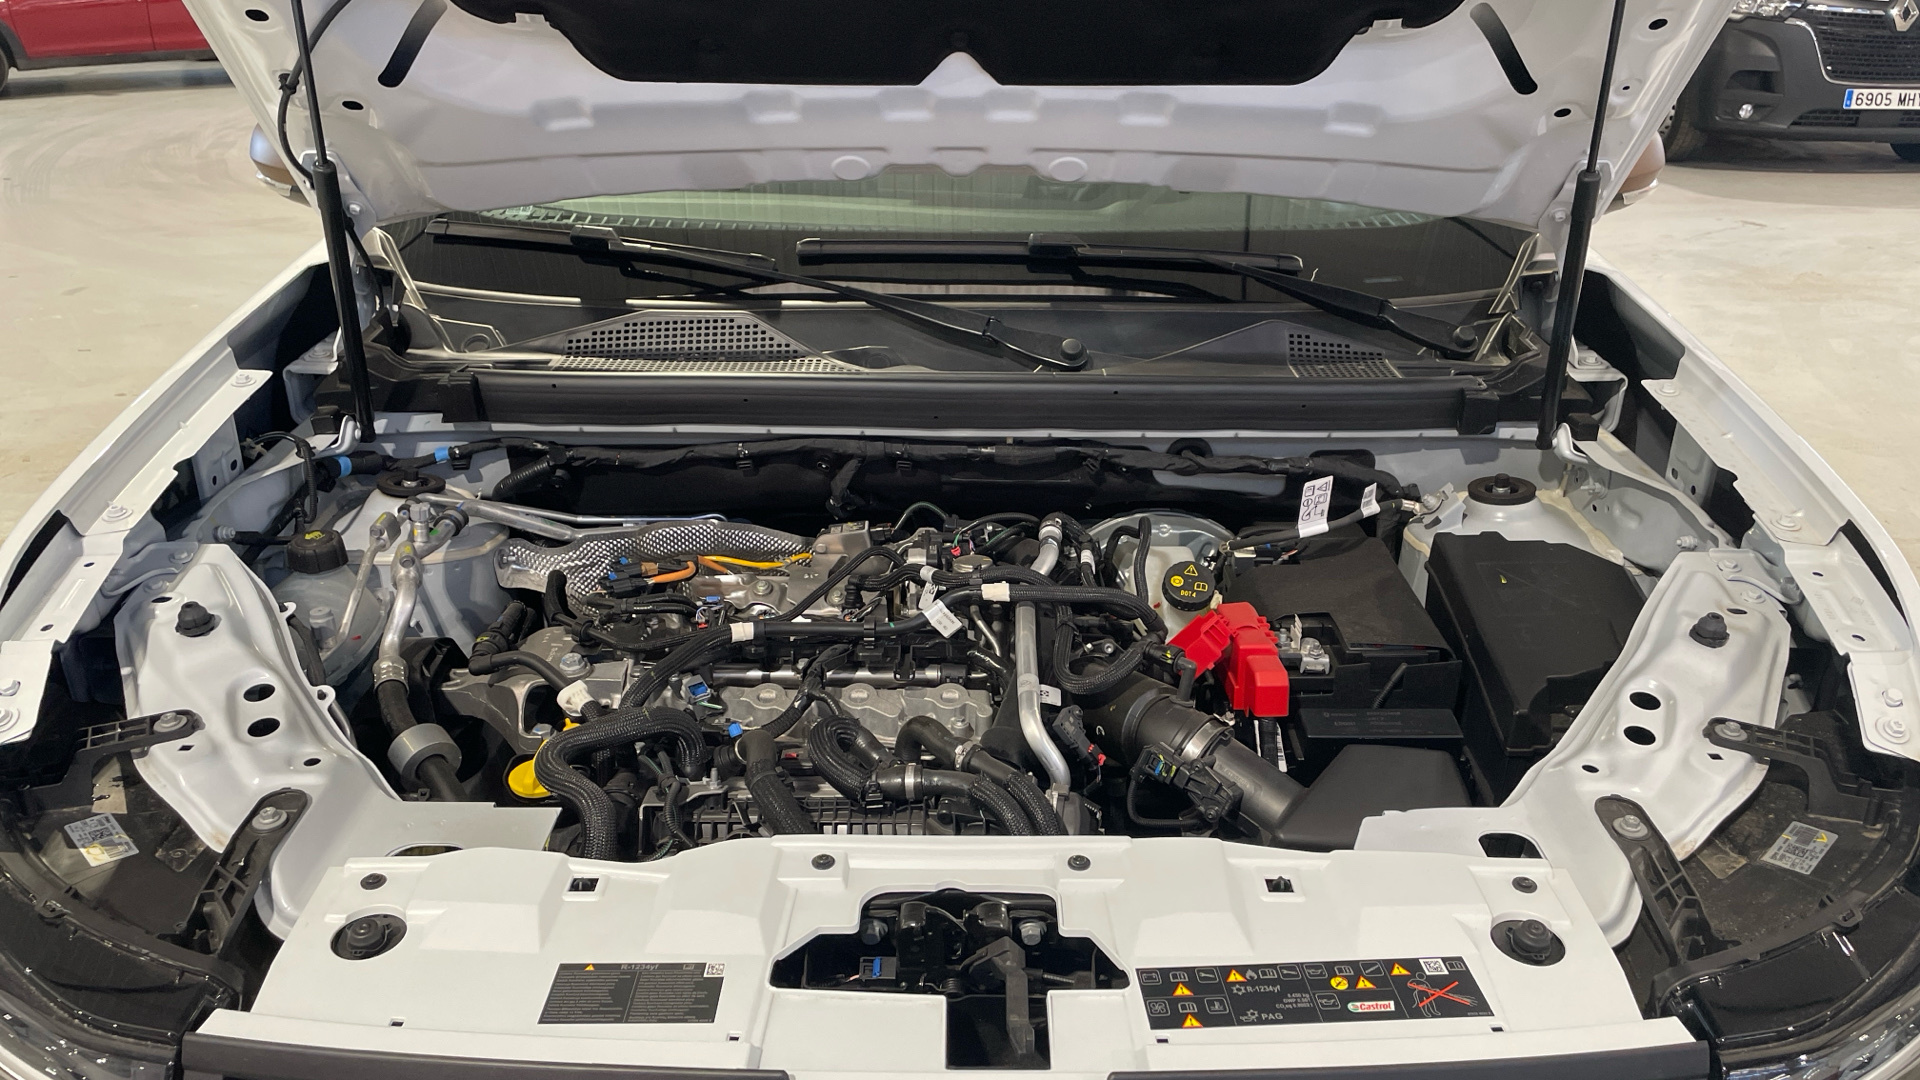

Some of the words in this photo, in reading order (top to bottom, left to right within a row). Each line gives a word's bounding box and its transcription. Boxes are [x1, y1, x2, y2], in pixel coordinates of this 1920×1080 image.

[1855, 92, 1892, 106] 6905
[1246, 985, 1281, 993] R-1234yf
[1360, 1002, 1392, 1011] Castrol
[1261, 1012, 1284, 1020] PAG
